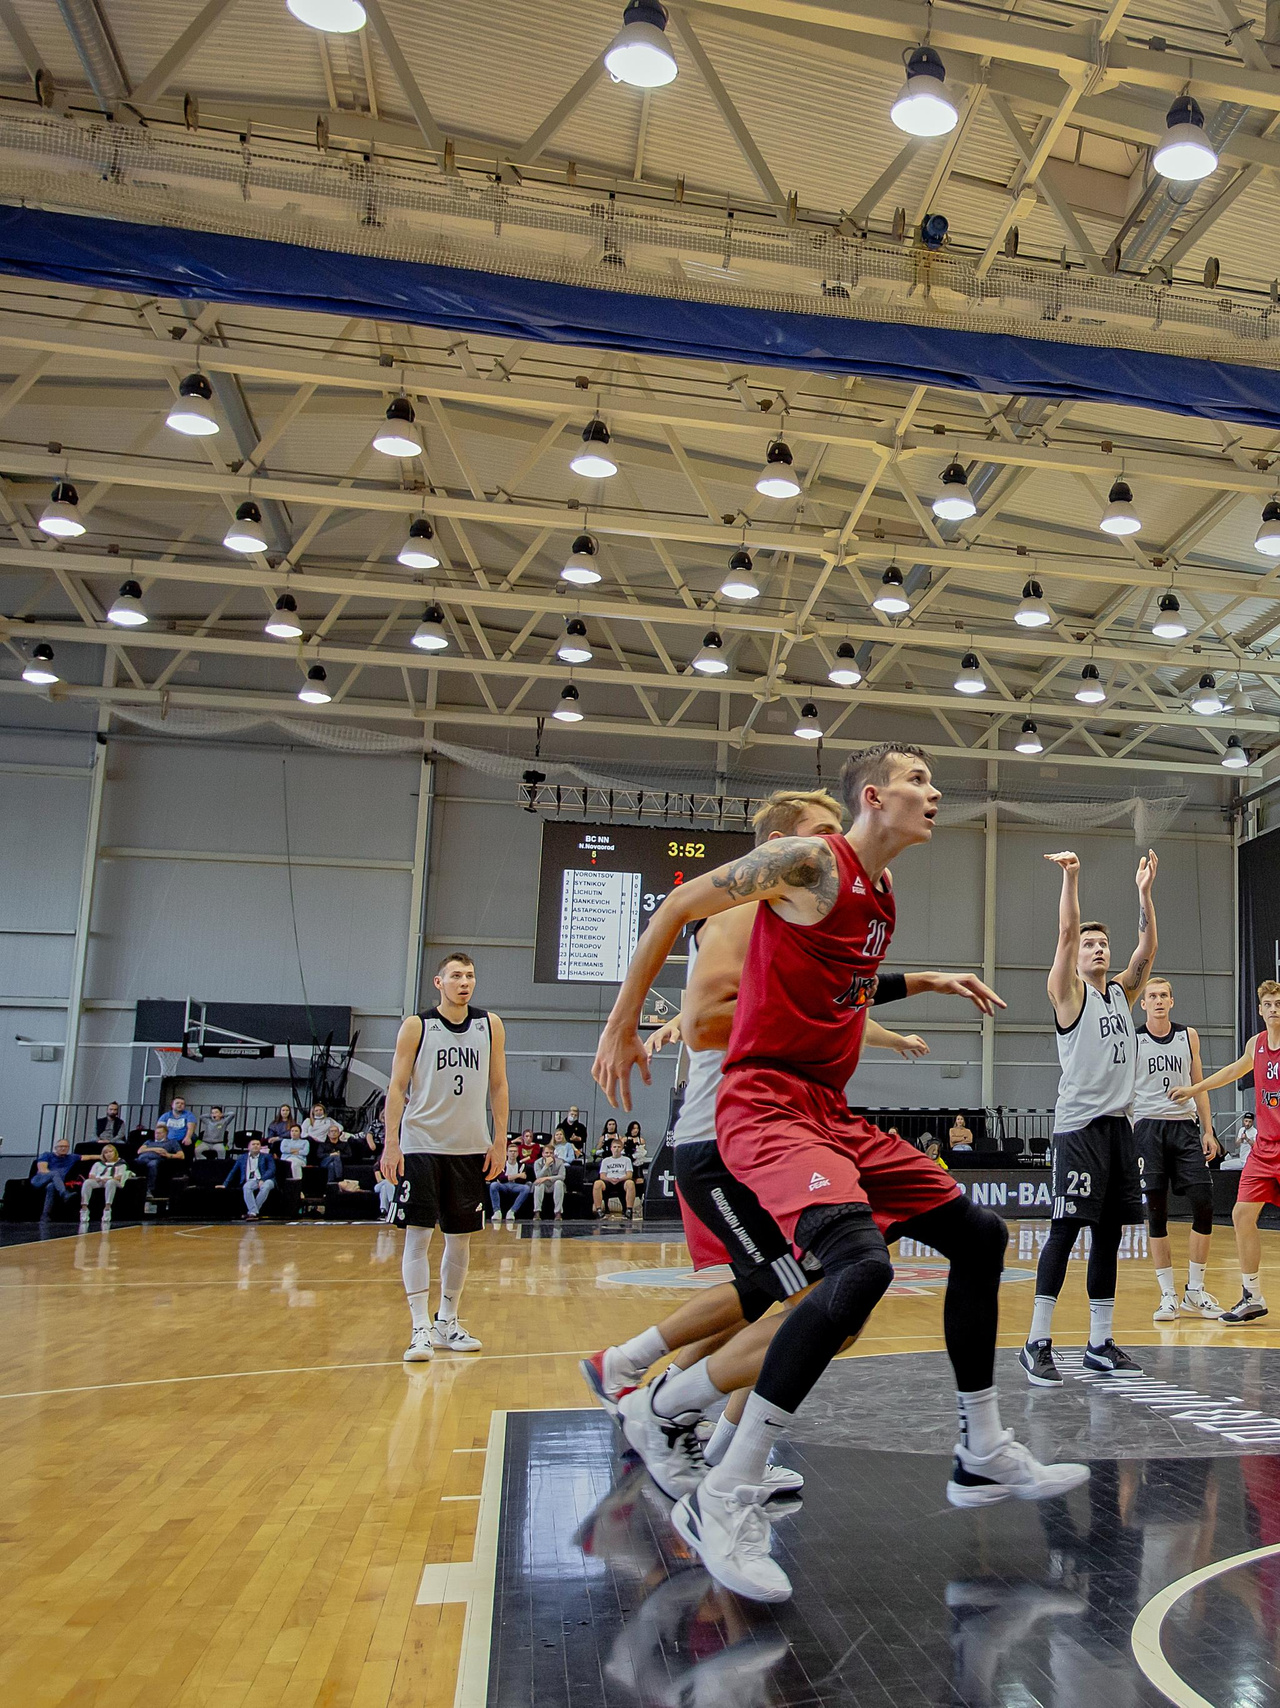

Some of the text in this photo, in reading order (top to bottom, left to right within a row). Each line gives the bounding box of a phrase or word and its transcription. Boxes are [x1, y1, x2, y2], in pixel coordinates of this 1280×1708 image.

[585, 835, 597, 843] BC
[667, 841, 706, 858] 3:52
[673, 870, 684, 885] 2
[642, 893, 667, 912] 3
[862, 918, 887, 957] 20
[436, 1047, 480, 1072] BCNN
[1148, 1054, 1182, 1075] BCNN
[1266, 1061, 1279, 1080] 34
[453, 1074, 464, 1096] 3
[1162, 1077, 1170, 1094] 9
[1137, 1156, 1145, 1175] 9
[400, 1180, 411, 1203] 3
[809, 1179, 831, 1191] PEAK
[955, 1182, 1052, 1206] NN-BA
[1066, 1170, 1092, 1197] 23
[710, 1187, 741, 1229] NOVGOROD
[732, 1226, 758, 1255] NIZHNY
